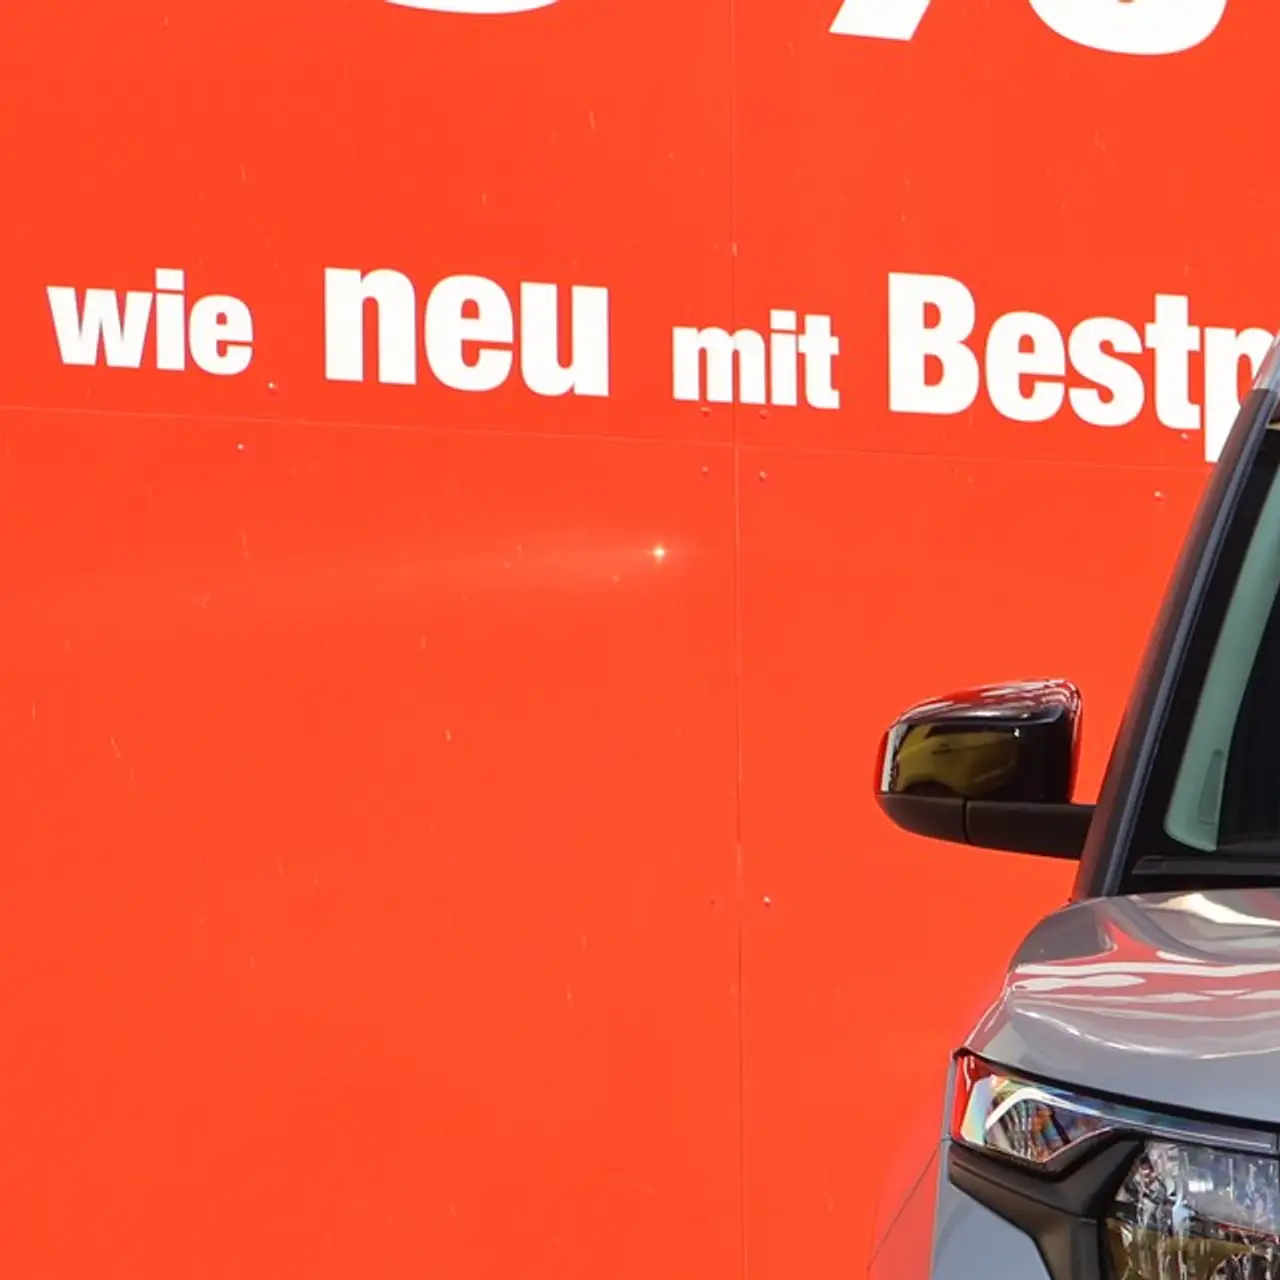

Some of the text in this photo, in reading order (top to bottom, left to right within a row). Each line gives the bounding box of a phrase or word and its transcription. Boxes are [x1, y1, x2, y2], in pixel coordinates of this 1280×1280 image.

[47, 268, 254, 376] wie
[325, 267, 609, 397] neu
[673, 310, 840, 410] mit
